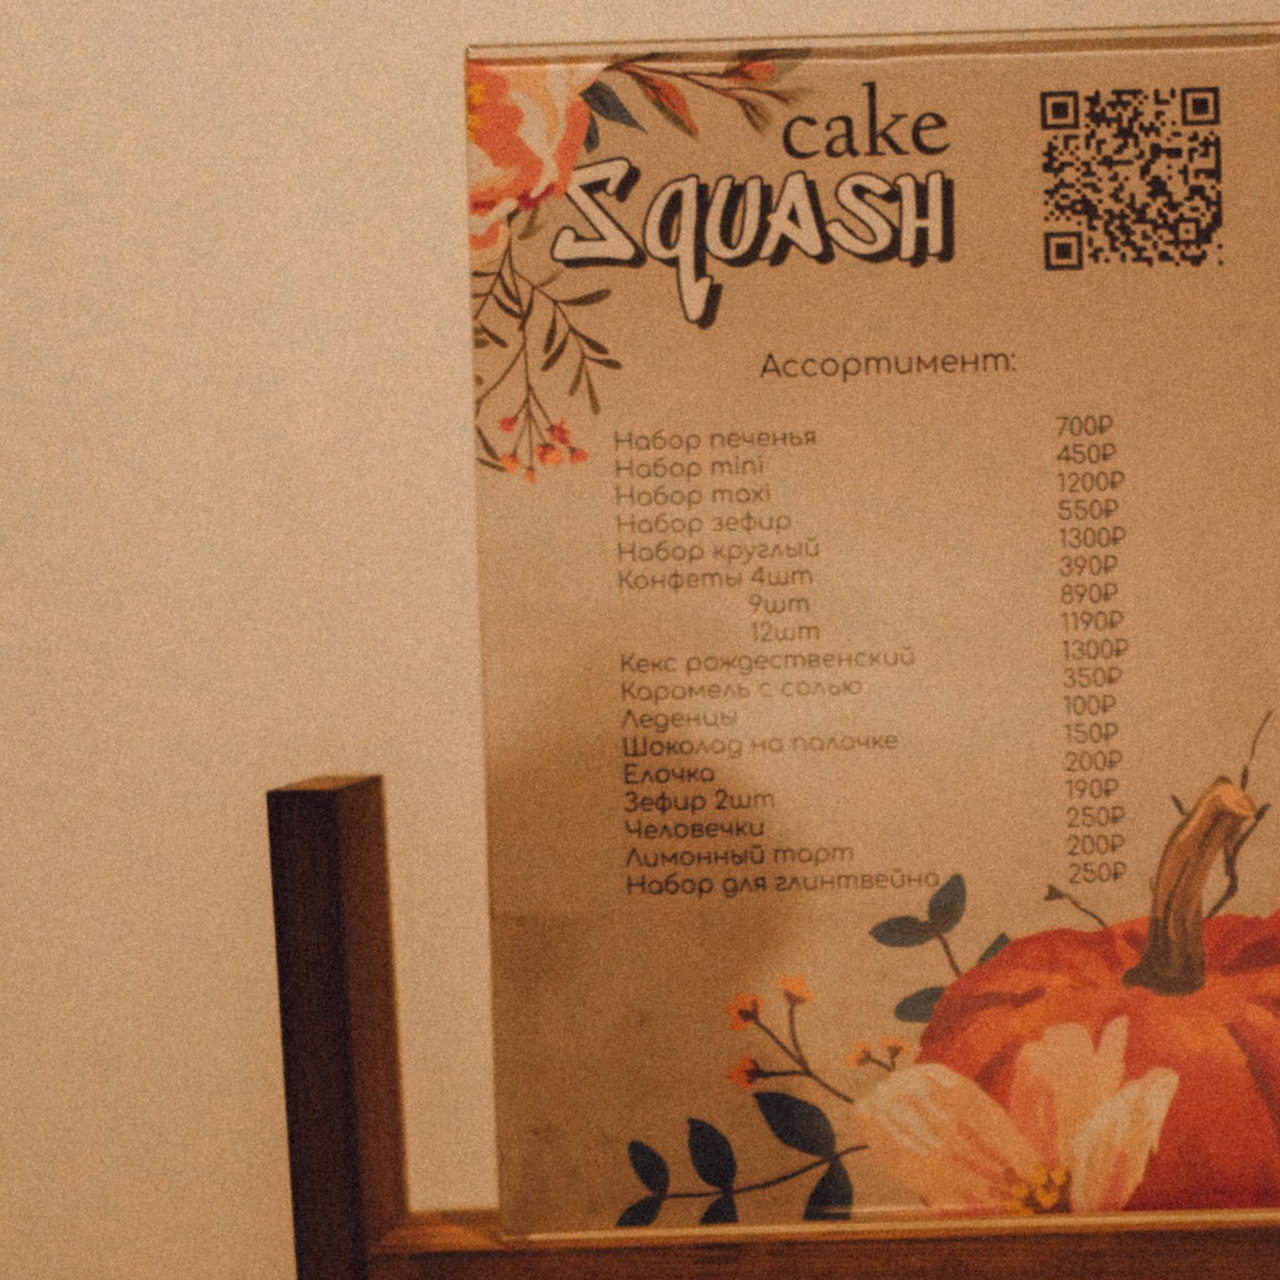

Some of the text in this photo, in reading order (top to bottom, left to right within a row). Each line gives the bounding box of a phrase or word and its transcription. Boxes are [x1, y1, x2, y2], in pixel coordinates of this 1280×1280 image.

[782, 82, 951, 158] cake
[759, 350, 1017, 385] Ассортимент:
[614, 429, 701, 453] Набор
[710, 429, 817, 448] печенья
[614, 457, 701, 478] Набор
[711, 455, 764, 475] mini
[615, 484, 702, 507] Набор
[616, 512, 703, 535] Набор
[711, 510, 791, 535] зефир
[617, 540, 704, 562] Набор
[712, 537, 820, 565] круглый
[617, 569, 743, 591] Конфеты
[750, 566, 814, 585] 4шт
[750, 621, 821, 643] 12шт
[620, 653, 677, 673] Кекс
[620, 681, 751, 704] Карамель
[622, 736, 744, 759] Шоколад
[749, 738, 785, 754] на
[791, 732, 899, 753] палочке
[623, 763, 717, 785] Елочка
[624, 790, 708, 814] Зефир
[714, 788, 775, 810] 2шт
[625, 818, 765, 841] Человечки
[625, 845, 766, 869] Лимонный
[773, 843, 854, 867] тарт
[626, 872, 714, 898] Набор
[722, 873, 768, 898] для
